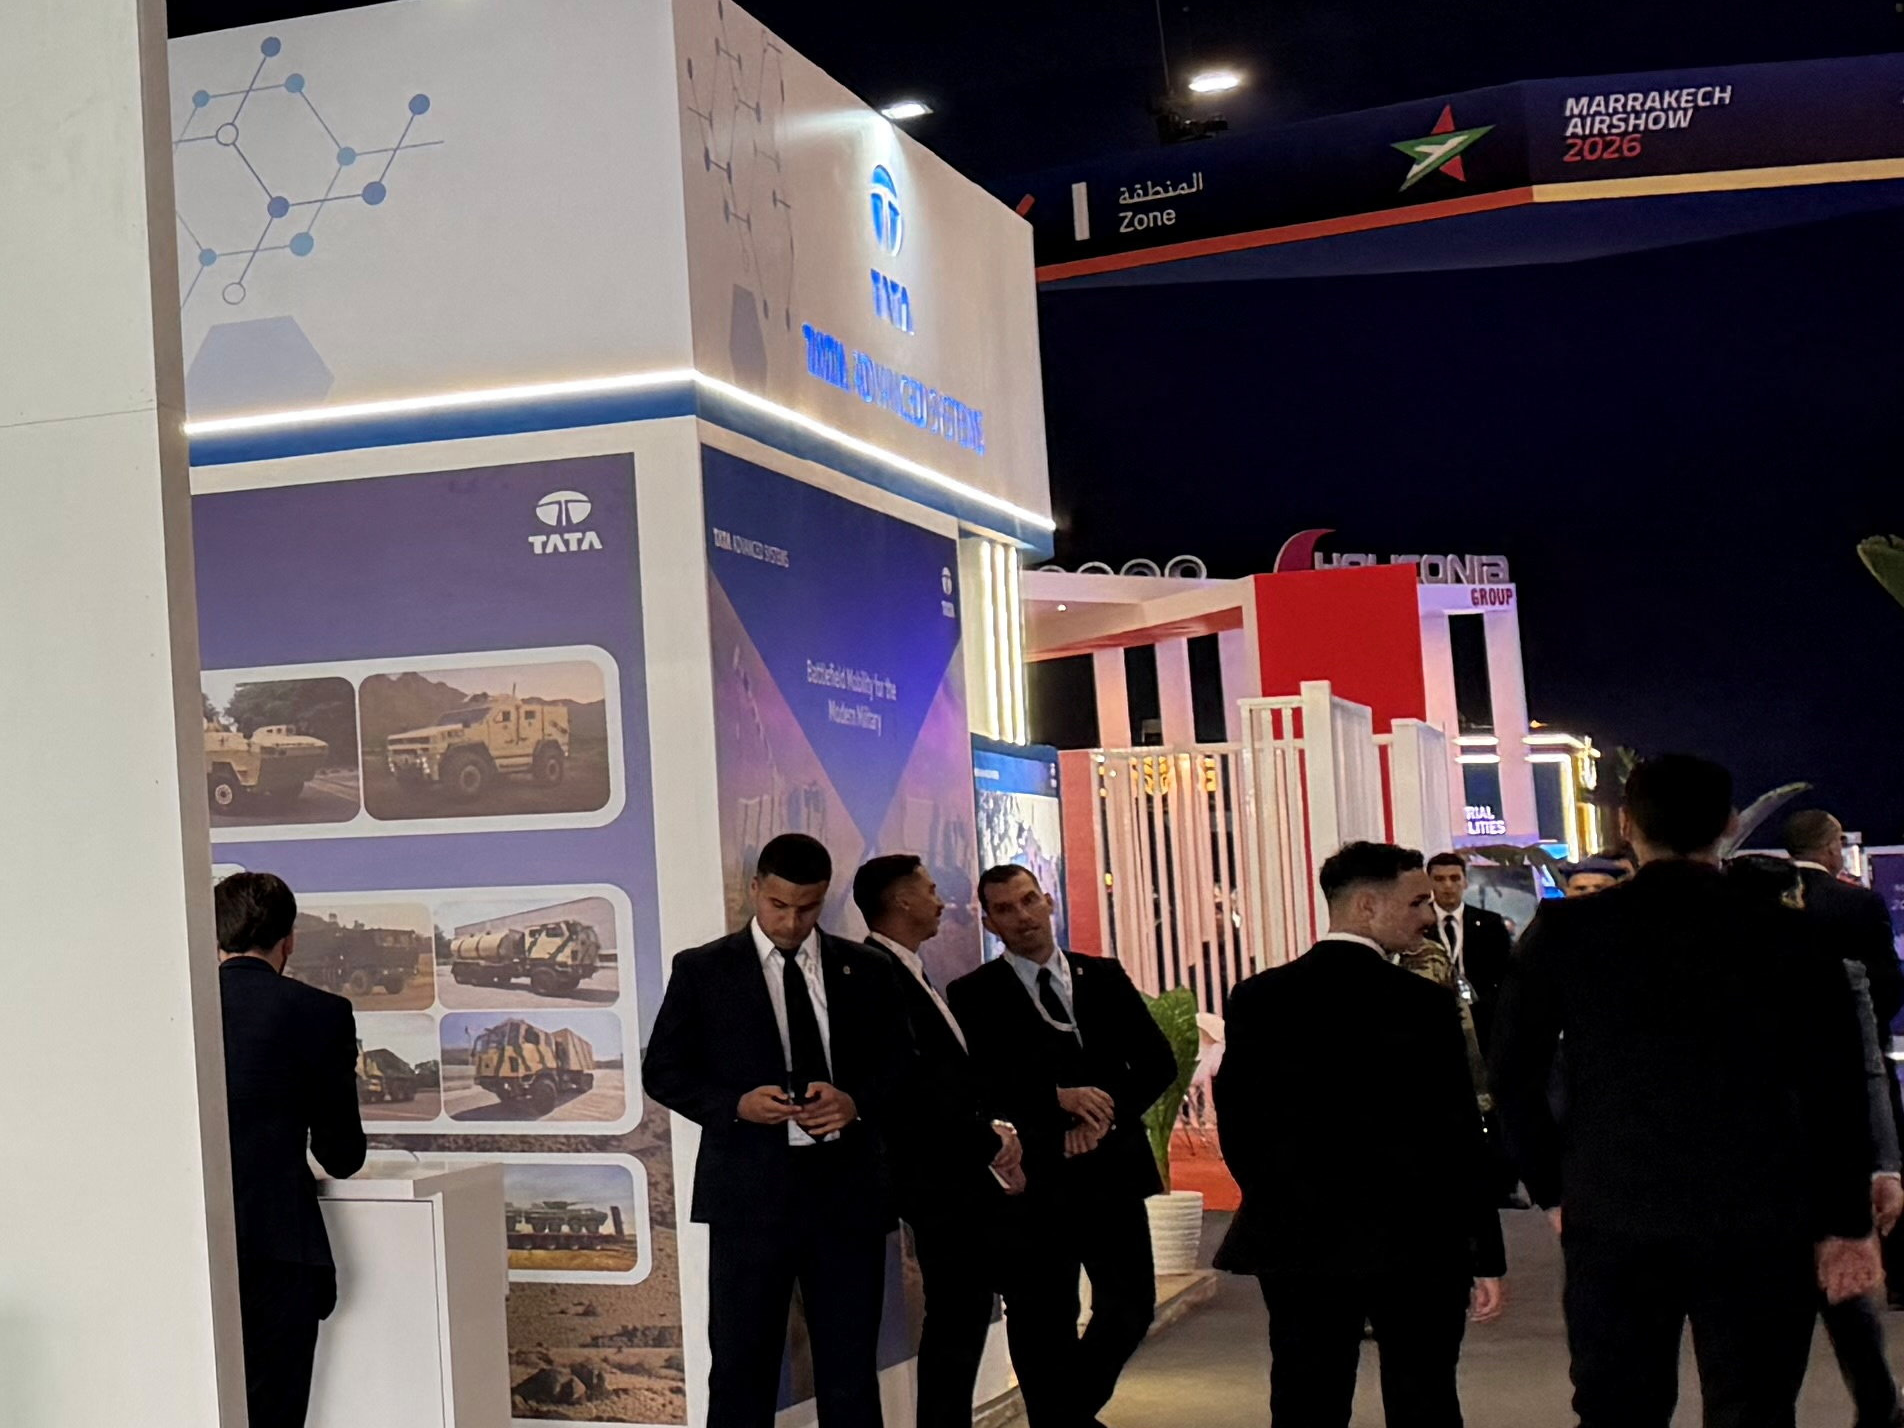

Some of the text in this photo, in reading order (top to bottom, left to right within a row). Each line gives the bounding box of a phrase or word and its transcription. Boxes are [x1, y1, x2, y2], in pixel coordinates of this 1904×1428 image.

[1565, 85, 1732, 117] MARRAKECH
[1565, 108, 1693, 137] AIRSHOW
[1562, 133, 1642, 163] 2026
[1118, 171, 1204, 206] المنطقة
[1118, 206, 1177, 234] Zone
[528, 530, 603, 554] TATA
[1471, 587, 1513, 606] GROUP
